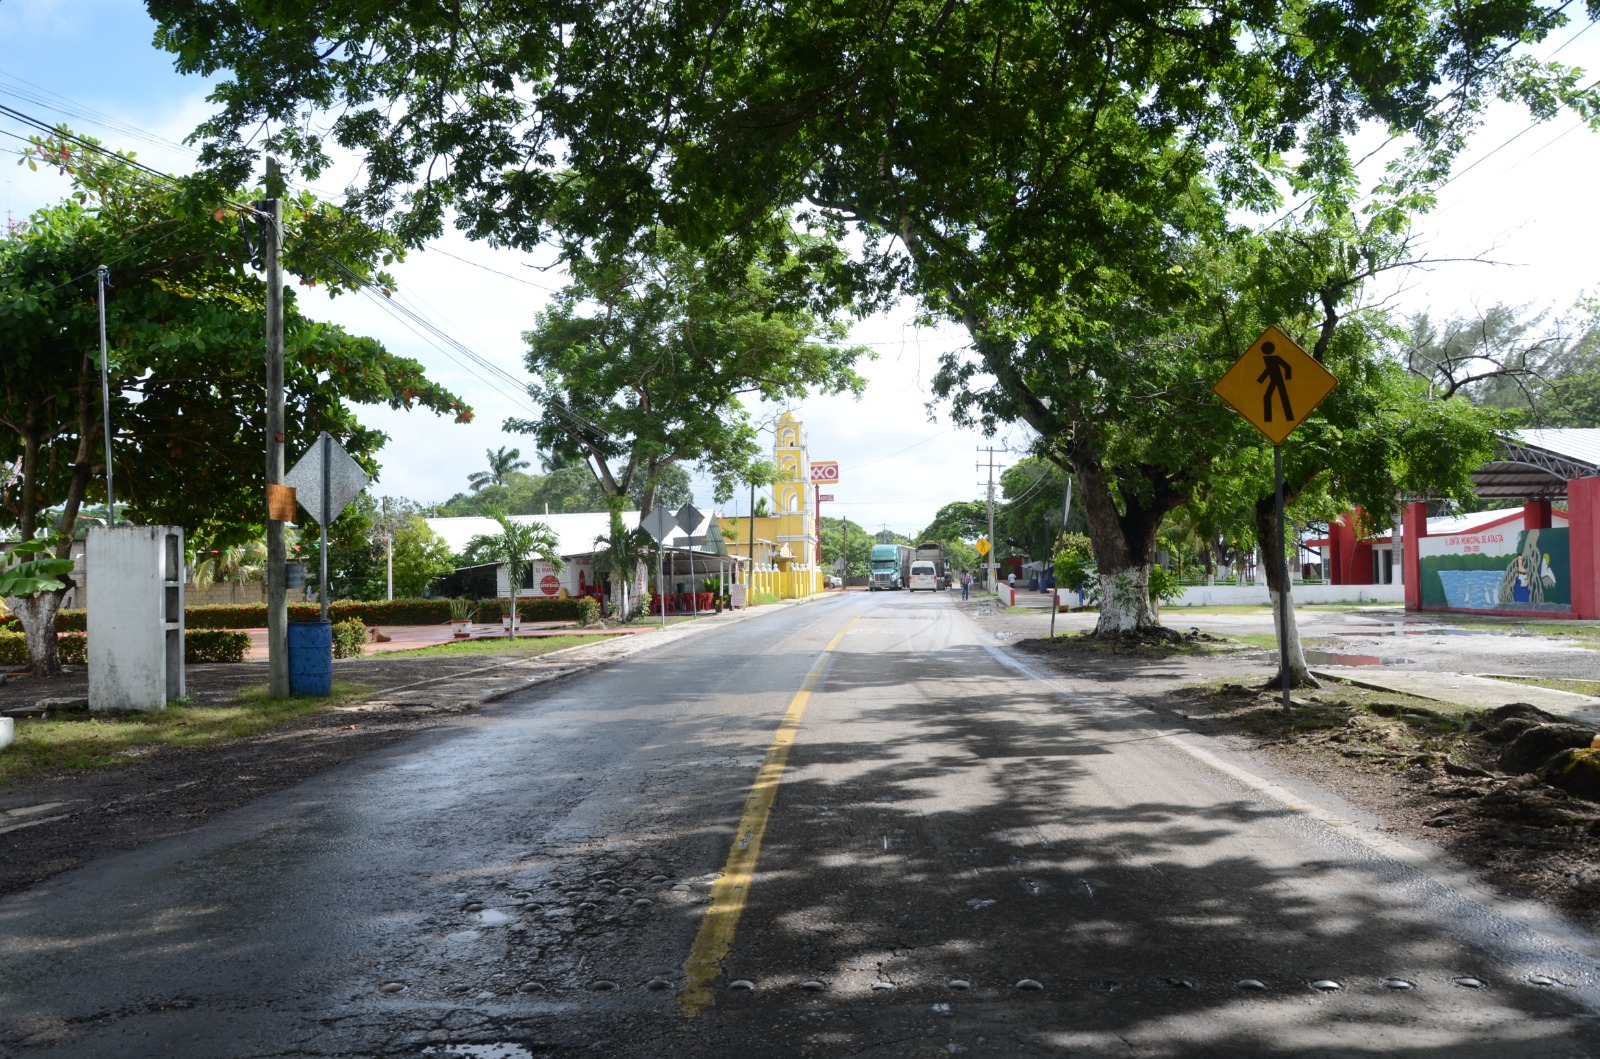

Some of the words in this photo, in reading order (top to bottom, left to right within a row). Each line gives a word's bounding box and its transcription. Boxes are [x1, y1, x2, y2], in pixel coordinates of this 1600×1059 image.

[1450, 537, 1460, 545] JUNTA
[1461, 535, 1481, 544] MUNICIPAL
[1482, 535, 1487, 543] DE
[1488, 534, 1503, 543] ATASTA
